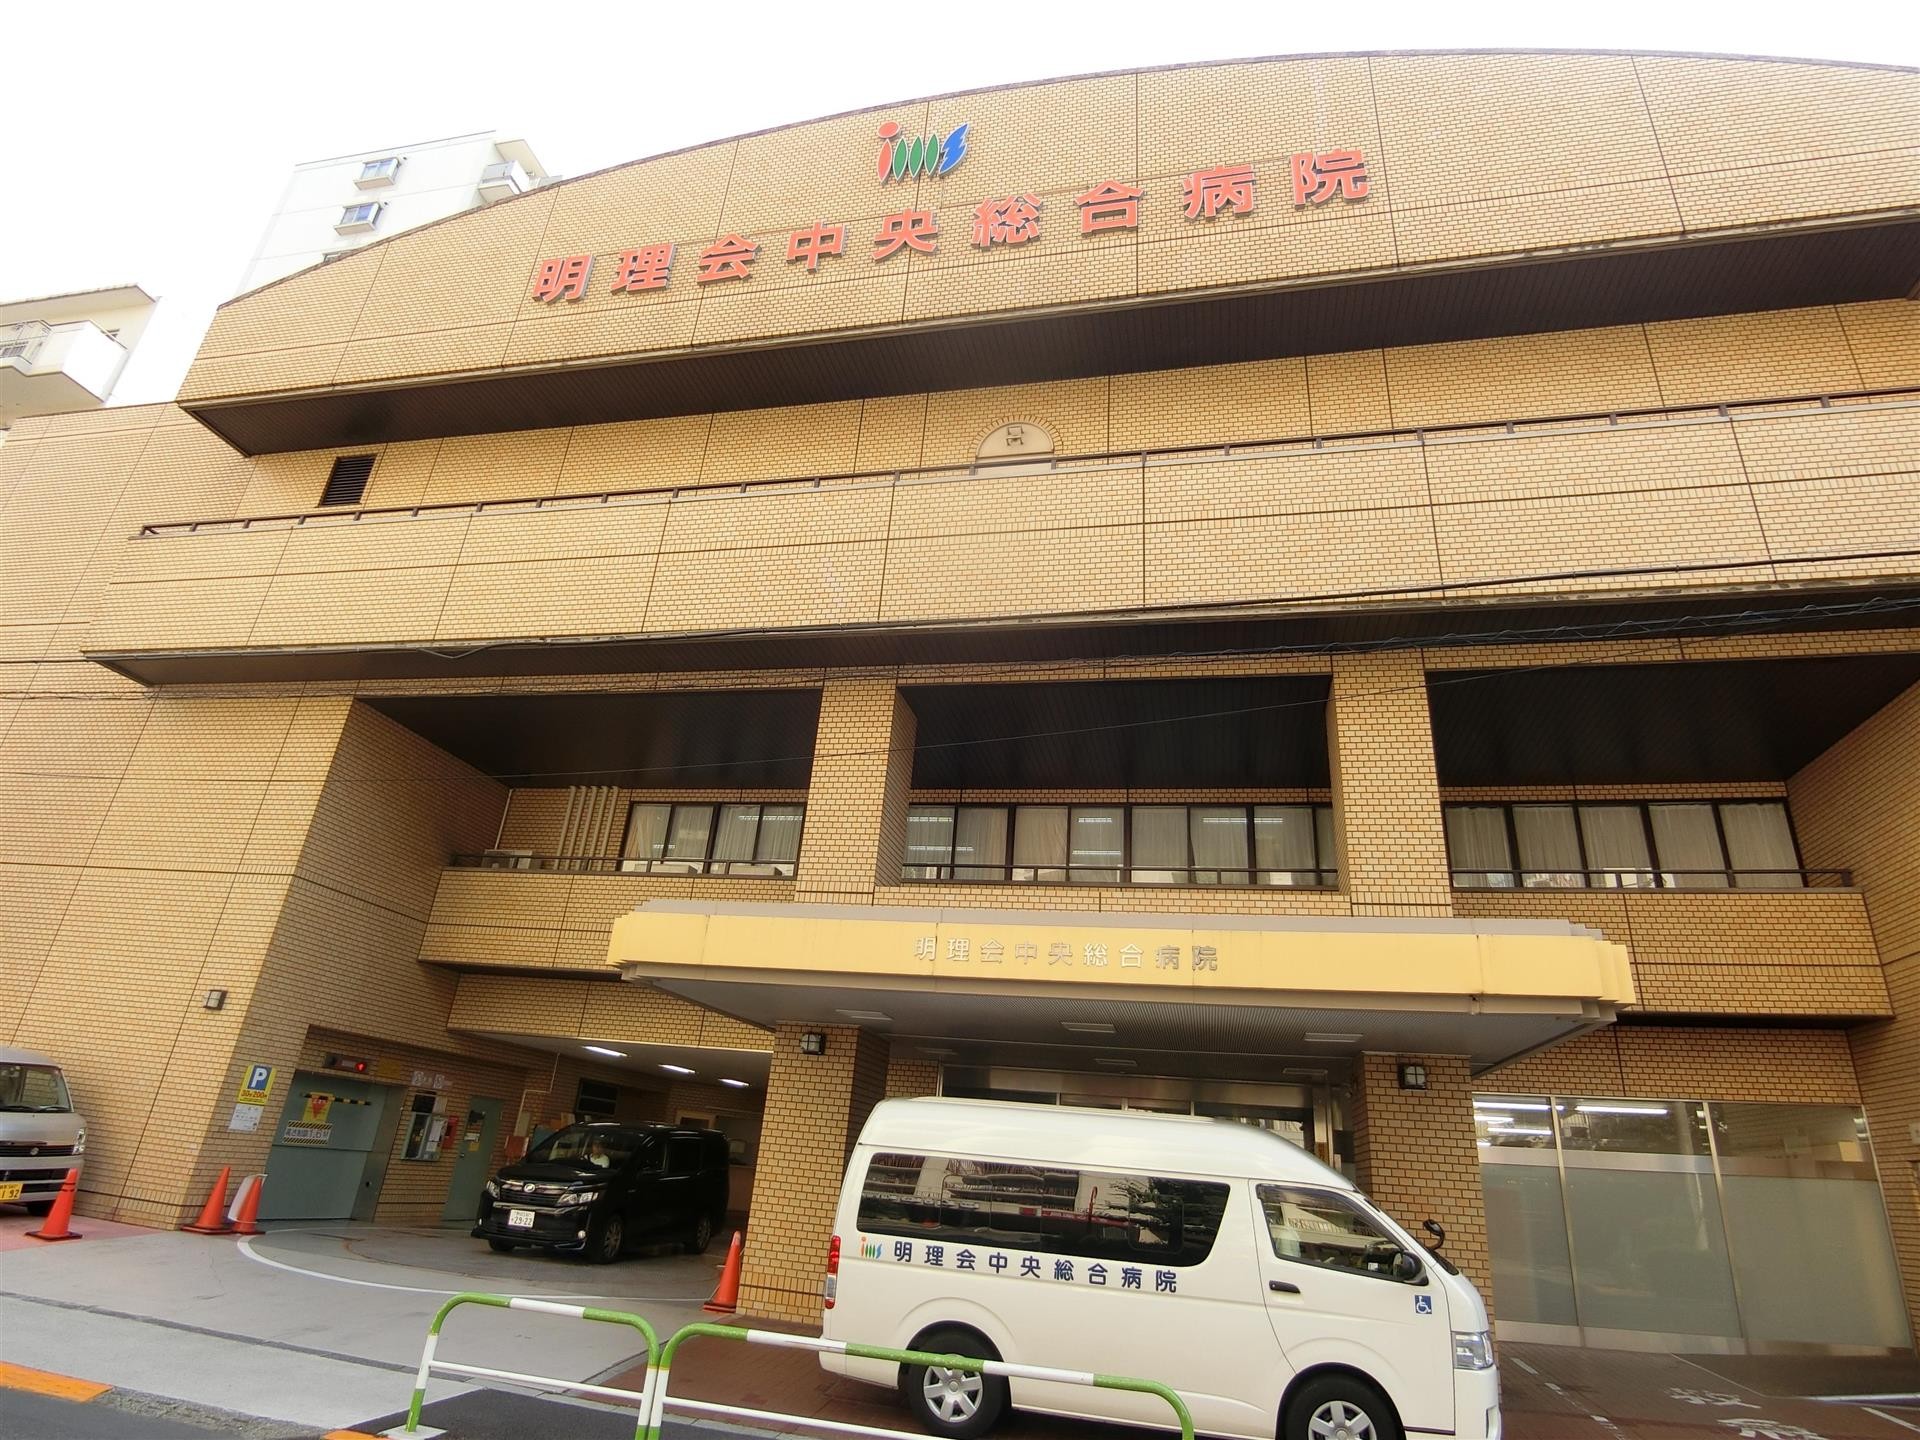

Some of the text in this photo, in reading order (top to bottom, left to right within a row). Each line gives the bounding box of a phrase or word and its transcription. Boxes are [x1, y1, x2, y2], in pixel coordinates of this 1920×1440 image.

[530, 147, 1371, 304] 明理会中央総合病院
[913, 936, 1218, 972] 明理会中央総合病院
[250, 1067, 267, 1088] P
[893, 1240, 1178, 1293] 明理会中央総合病院
